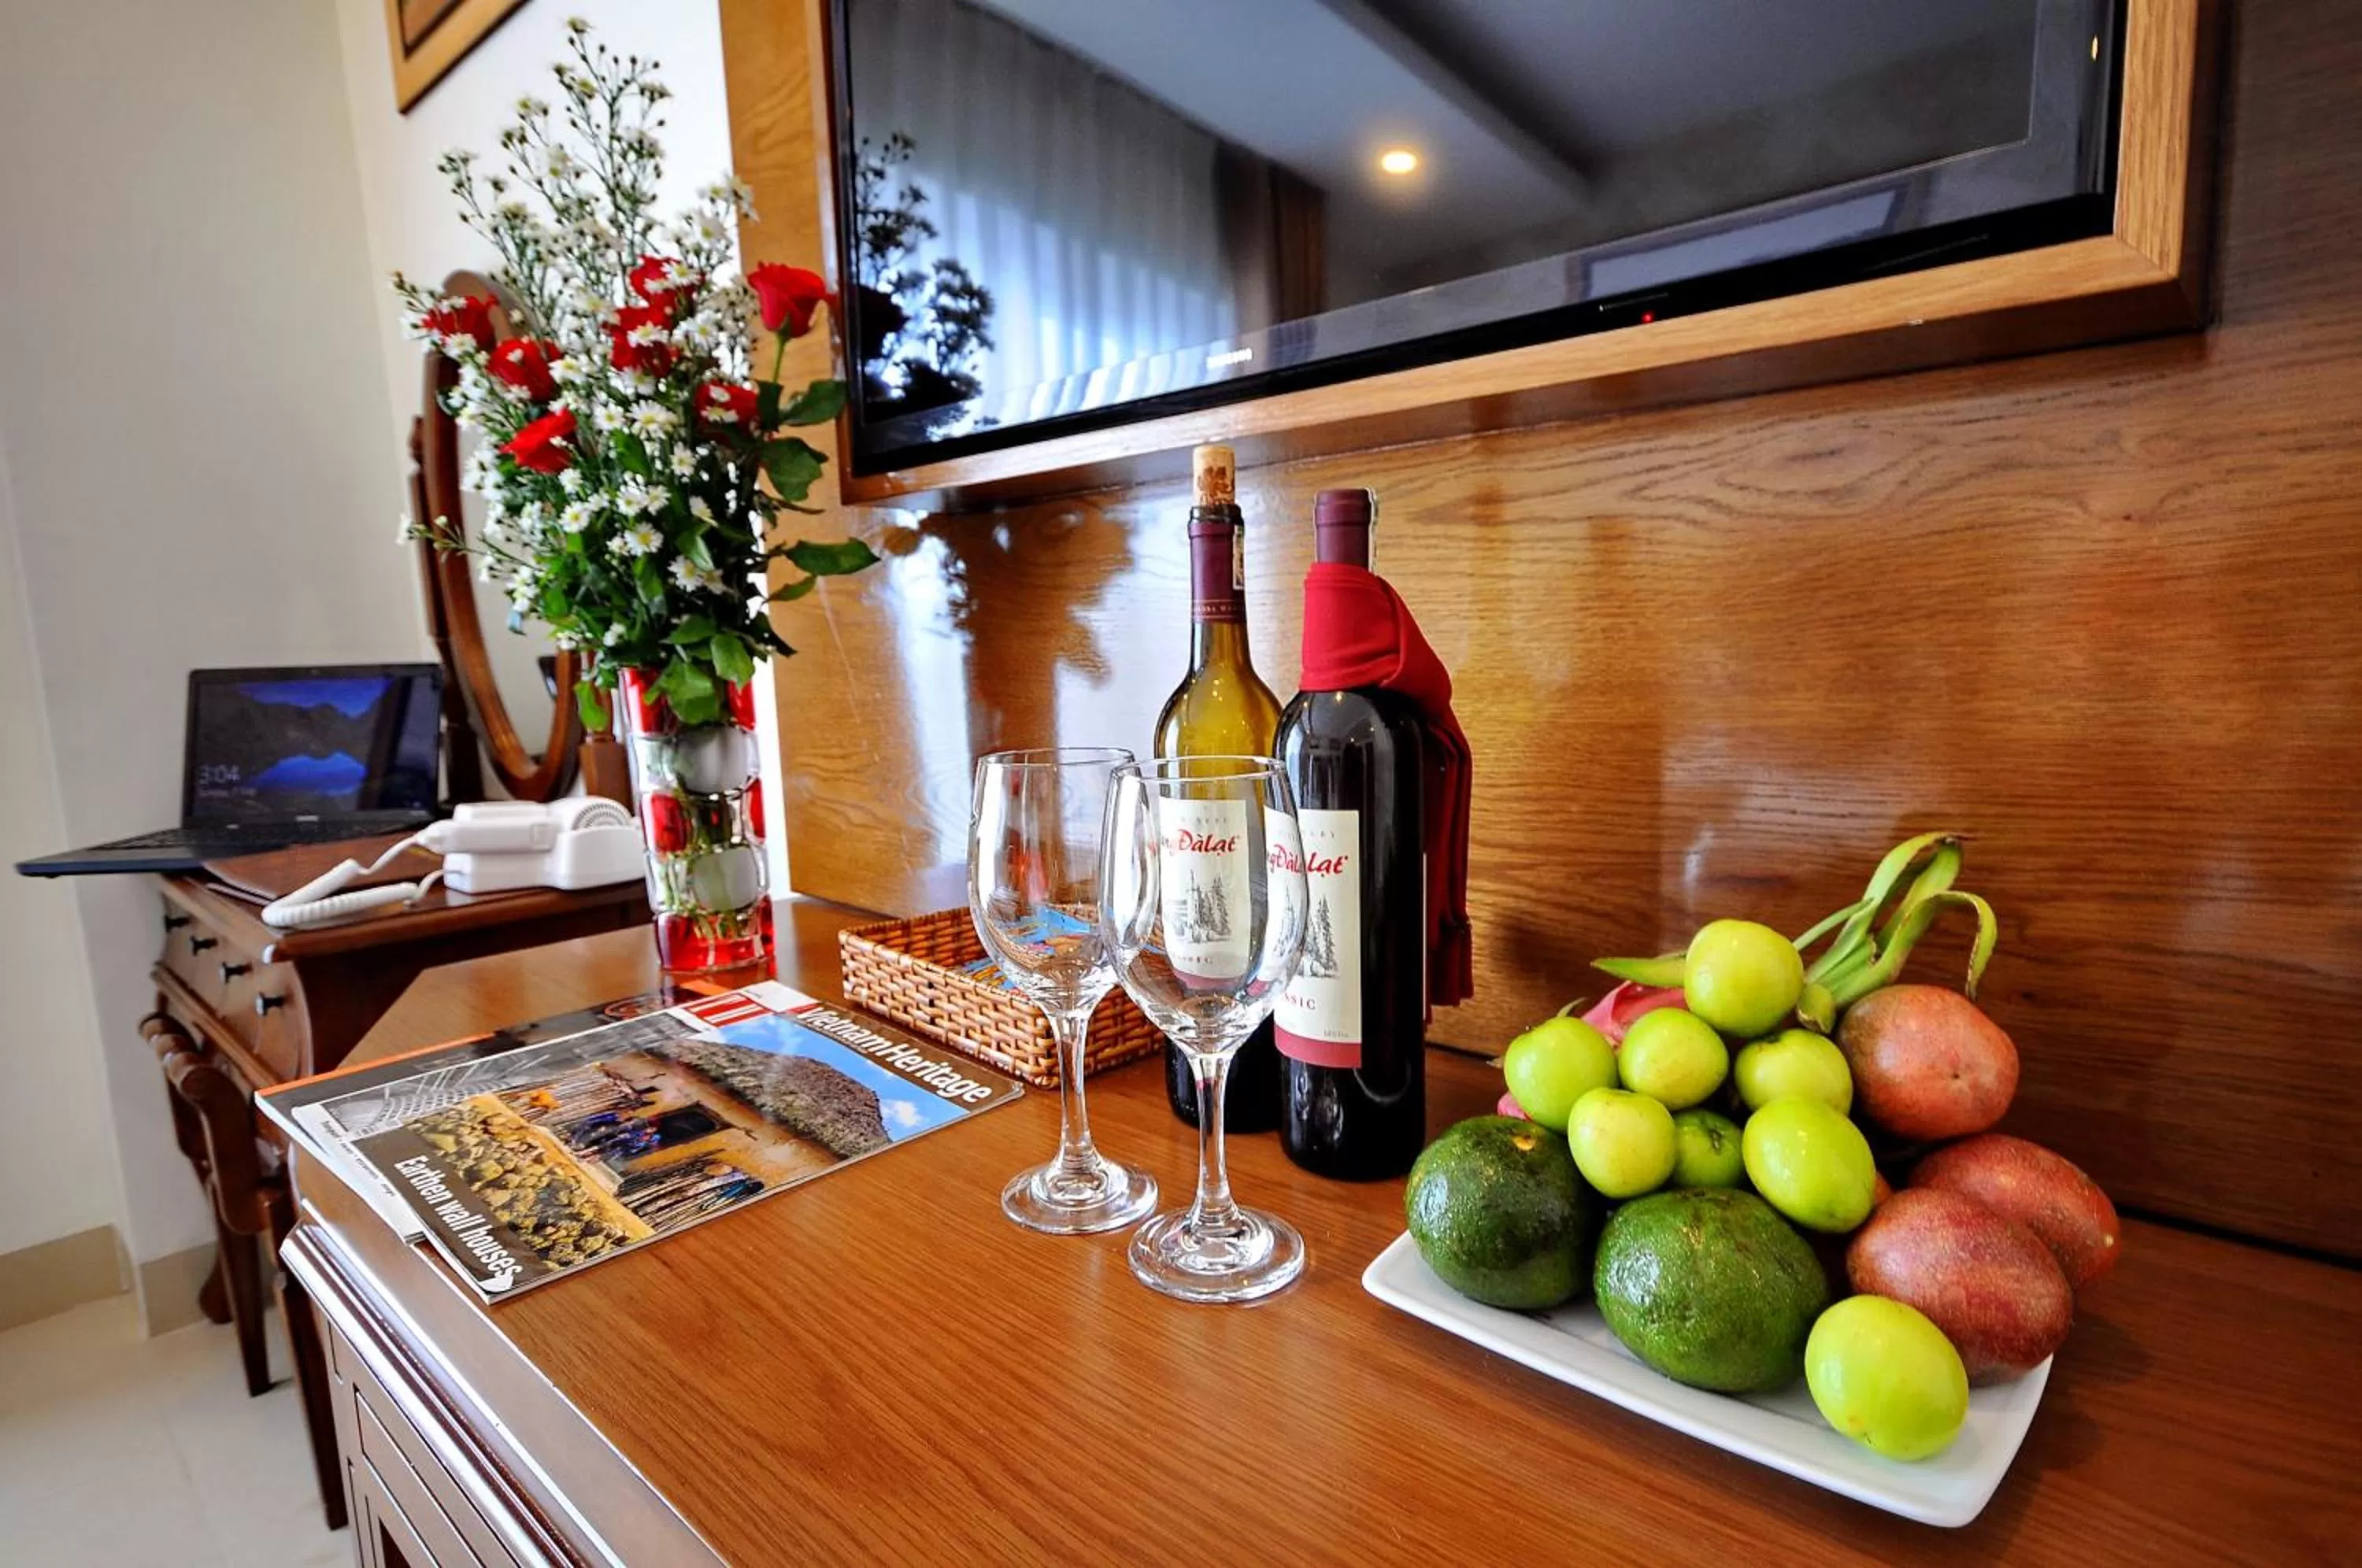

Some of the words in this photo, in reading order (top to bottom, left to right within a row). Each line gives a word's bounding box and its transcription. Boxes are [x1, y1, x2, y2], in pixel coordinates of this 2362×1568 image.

[394, 1155, 454, 1205] Earthen
[435, 1200, 487, 1231] wall
[474, 1225, 523, 1279] houses
